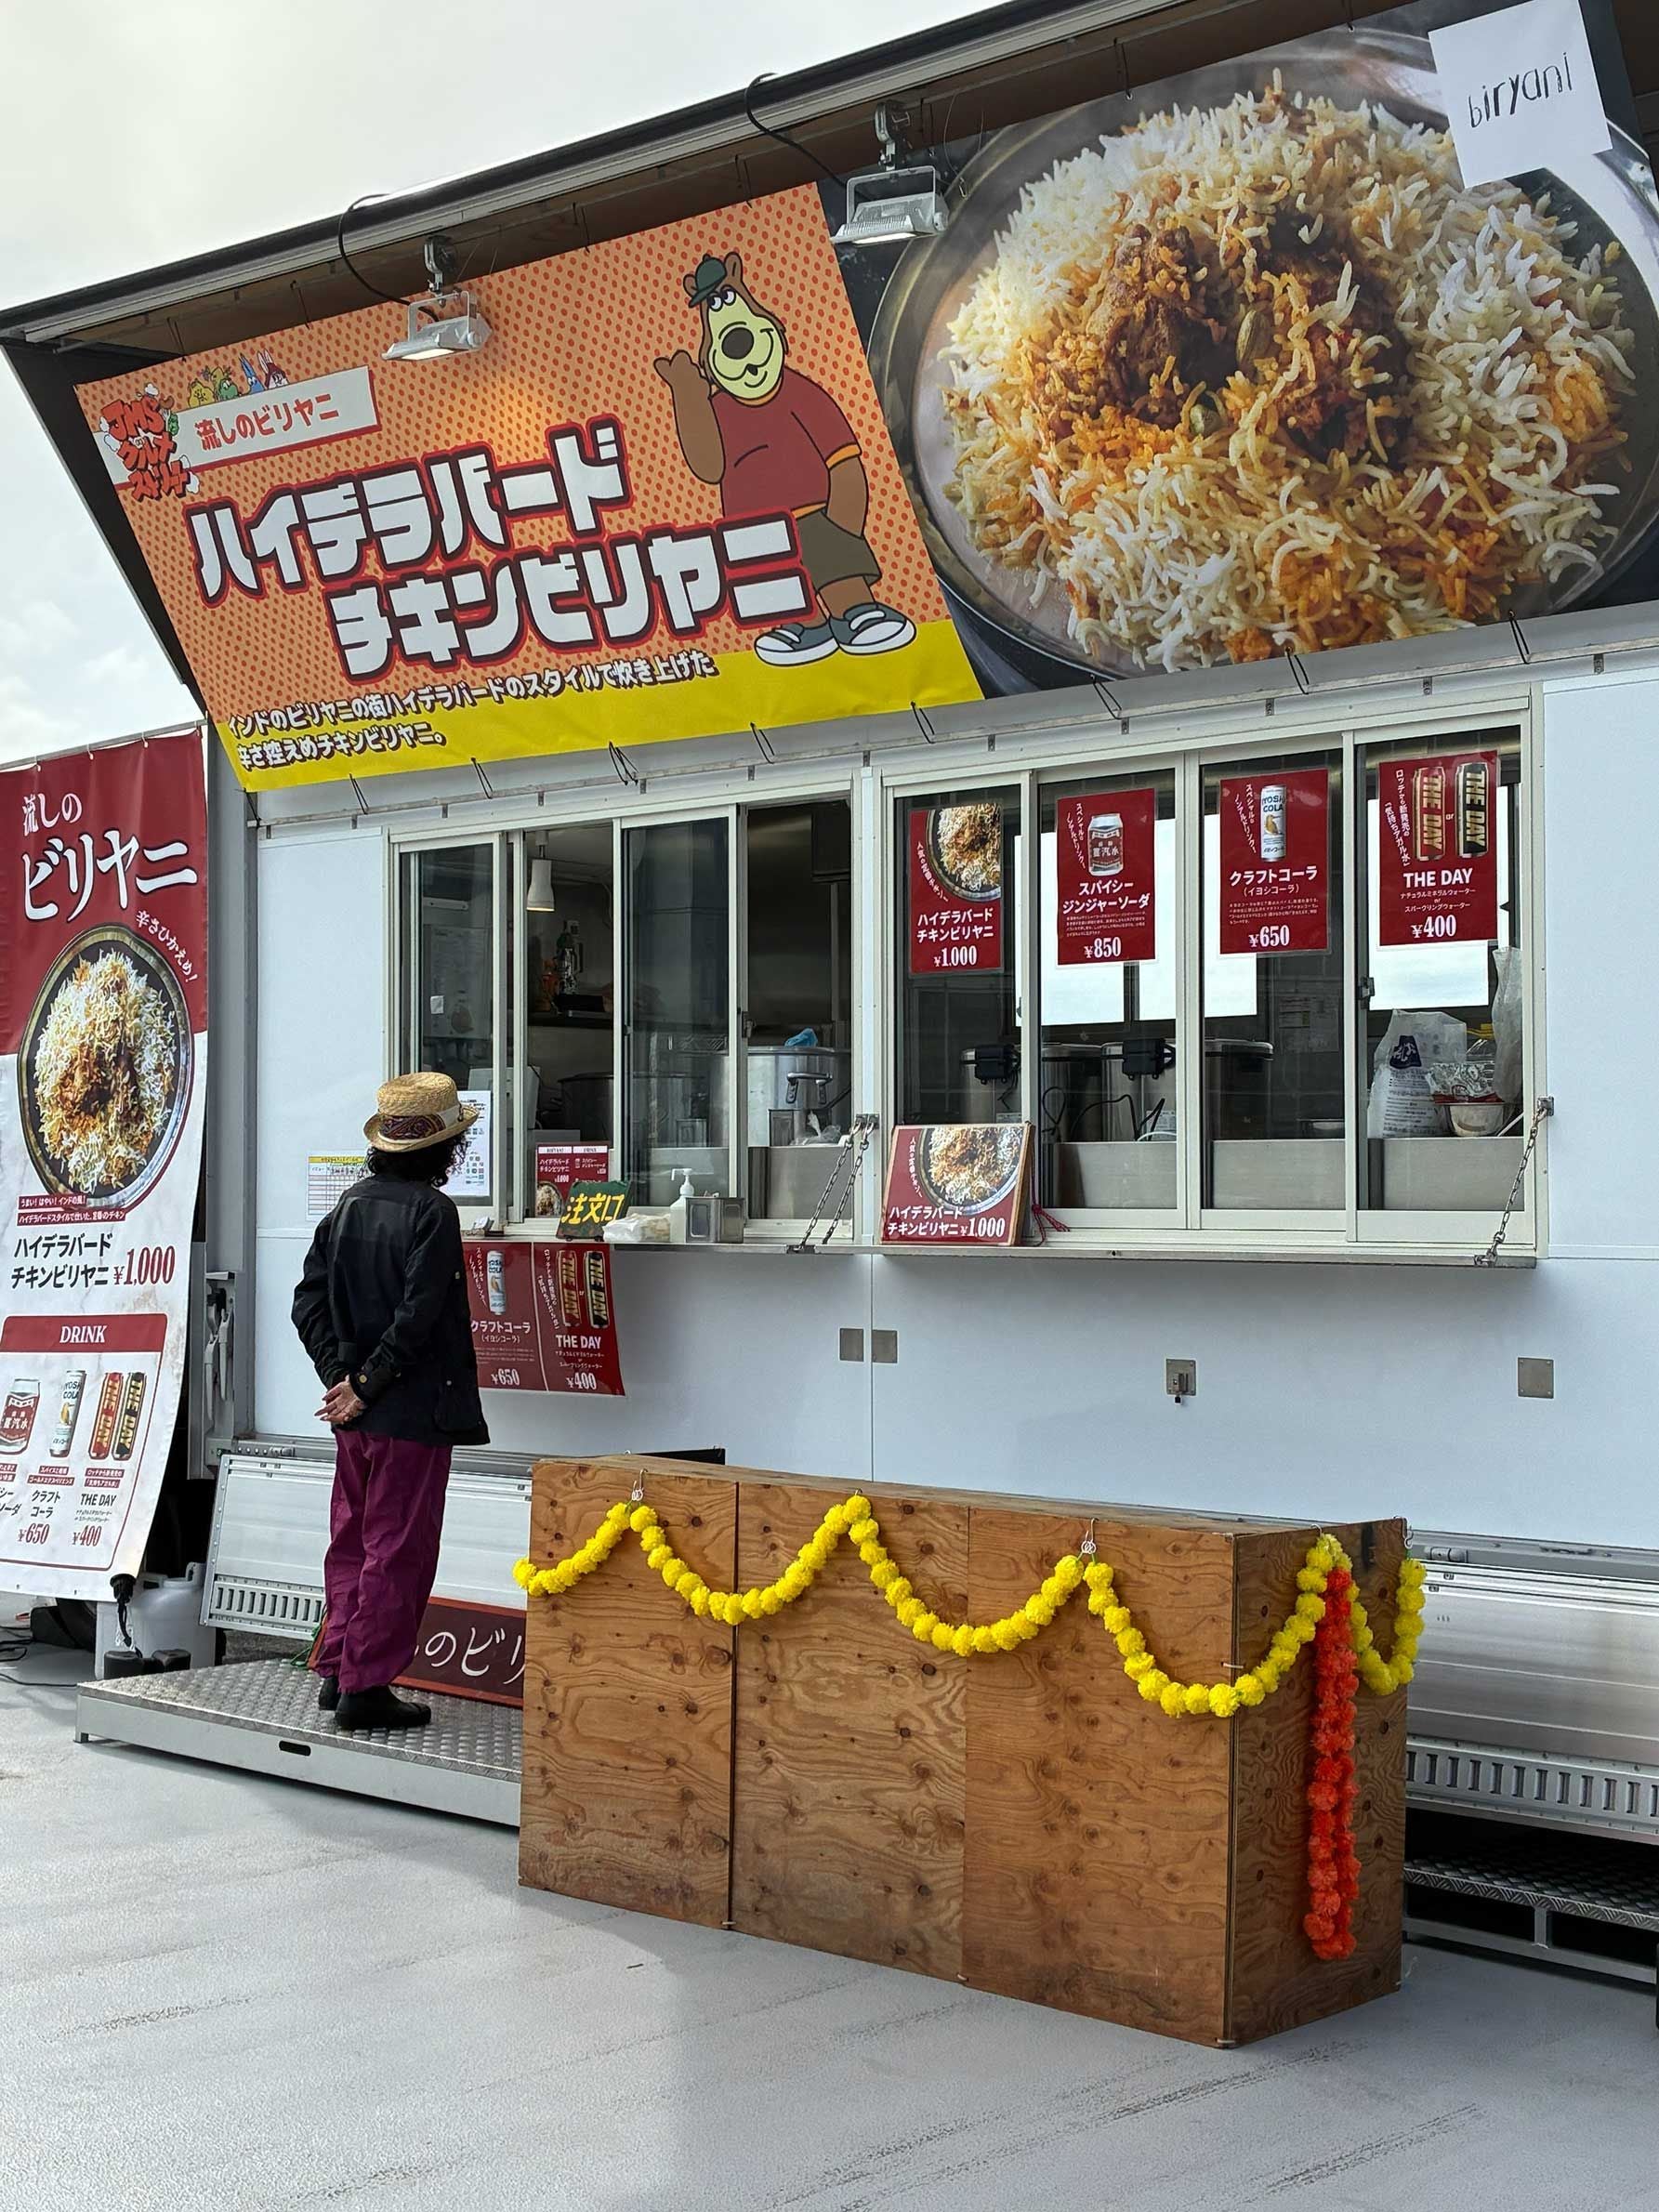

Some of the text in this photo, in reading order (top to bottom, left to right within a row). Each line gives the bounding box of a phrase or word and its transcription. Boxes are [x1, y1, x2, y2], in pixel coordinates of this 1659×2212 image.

[1468, 51, 1573, 128] biryani
[100, 394, 166, 441] JMS
[193, 393, 340, 450] 流しのビリヤニ
[188, 423, 627, 602] ハイデラバード
[327, 517, 810, 679] チキンビリヤニ
[22, 793, 82, 836] 流しの
[1423, 774, 1442, 849] THE DAY
[1466, 770, 1485, 847] THE DAY
[22, 830, 197, 922] ビリヤニ
[1078, 879, 1134, 896] スパイシー
[1229, 865, 1318, 887] クラフトコーラ
[1402, 868, 1473, 889] THE DAY
[1062, 892, 1151, 915] ジンジャーソーダ
[917, 907, 994, 927] ハイデラバード
[1411, 914, 1456, 939] ¥400
[916, 925, 994, 943] チキンビリヤニ
[1248, 925, 1290, 948] ¥650
[1084, 936, 1122, 958] ¥850
[561, 1192, 625, 1224] 注文口
[889, 1205, 963, 1218] ハイデラバード
[888, 1220, 960, 1236] チキンビリヤニ
[14, 1232, 113, 1258] ハイデラバード
[11, 1245, 176, 1289] チキンビリヤニ ¥1,000
[590, 1257, 608, 1323] THE DAY
[59, 1325, 107, 1344] DRINK
[470, 1321, 531, 1334] クラフトコーラ
[556, 1335, 601, 1350] THE DAY
[491, 1368, 520, 1386] ¥650
[566, 1372, 597, 1390] ¥400
[121, 1379, 143, 1450] THE DAY
[32, 1490, 60, 1503] クラフト
[80, 1493, 117, 1507] THE DAY
[31, 1507, 53, 1518] コーラ
[18, 1523, 49, 1545] ¥650
[72, 1524, 102, 1547] ¥400
